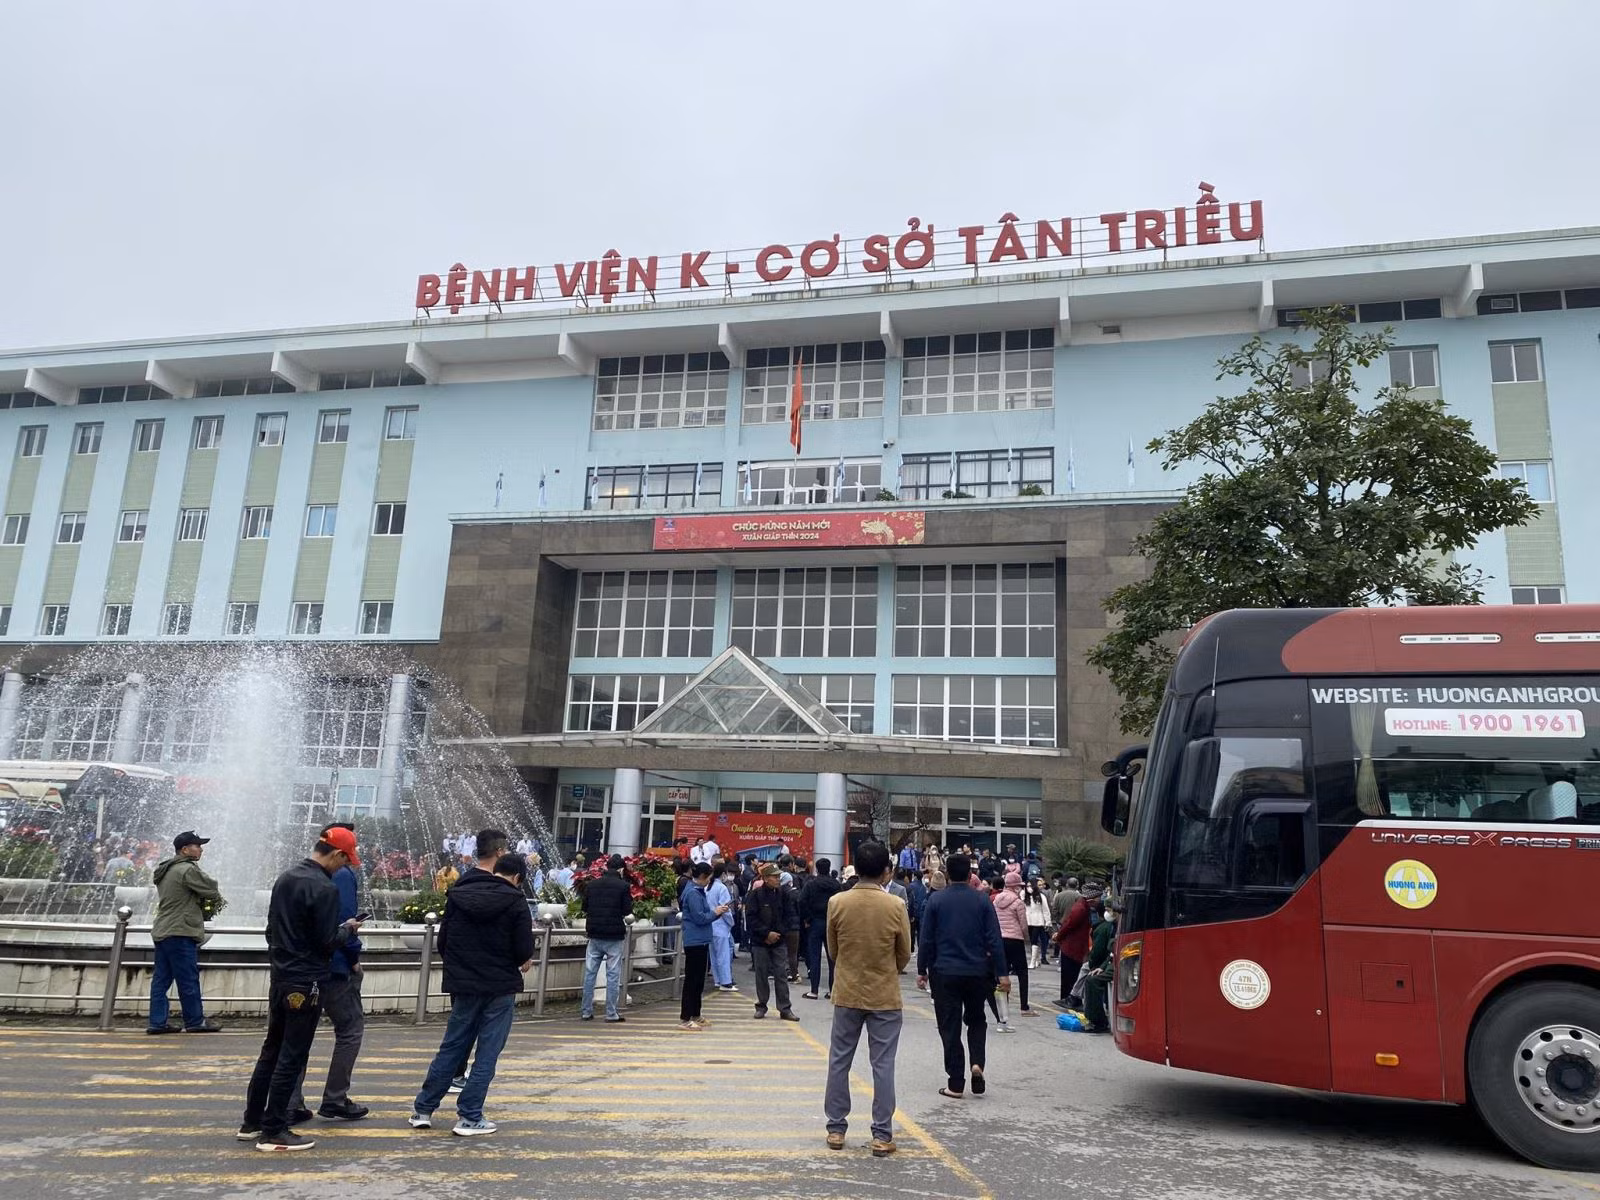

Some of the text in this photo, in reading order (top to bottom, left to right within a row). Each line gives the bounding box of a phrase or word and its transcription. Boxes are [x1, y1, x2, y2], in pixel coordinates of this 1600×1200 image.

[416, 262, 536, 314] BỆNH
[554, 249, 658, 303] VIỆN
[680, 251, 712, 289] K
[755, 233, 840, 282] CƠ
[862, 217, 935, 273] SỞ
[959, 212, 1073, 264] TÂN
[1100, 181, 1263, 252] TRIỀU
[732, 520, 759, 531] CHÚC
[789, 519, 811, 530] NĂM
[811, 519, 831, 530] MỚI
[742, 531, 819, 541] XUÂN GIÁP THÌN 2024
[1311, 687, 1409, 704] WEBSITE:
[1393, 713, 1577, 732] HOTLINE: 1900 1961
[1418, 881, 1435, 890] ANH
